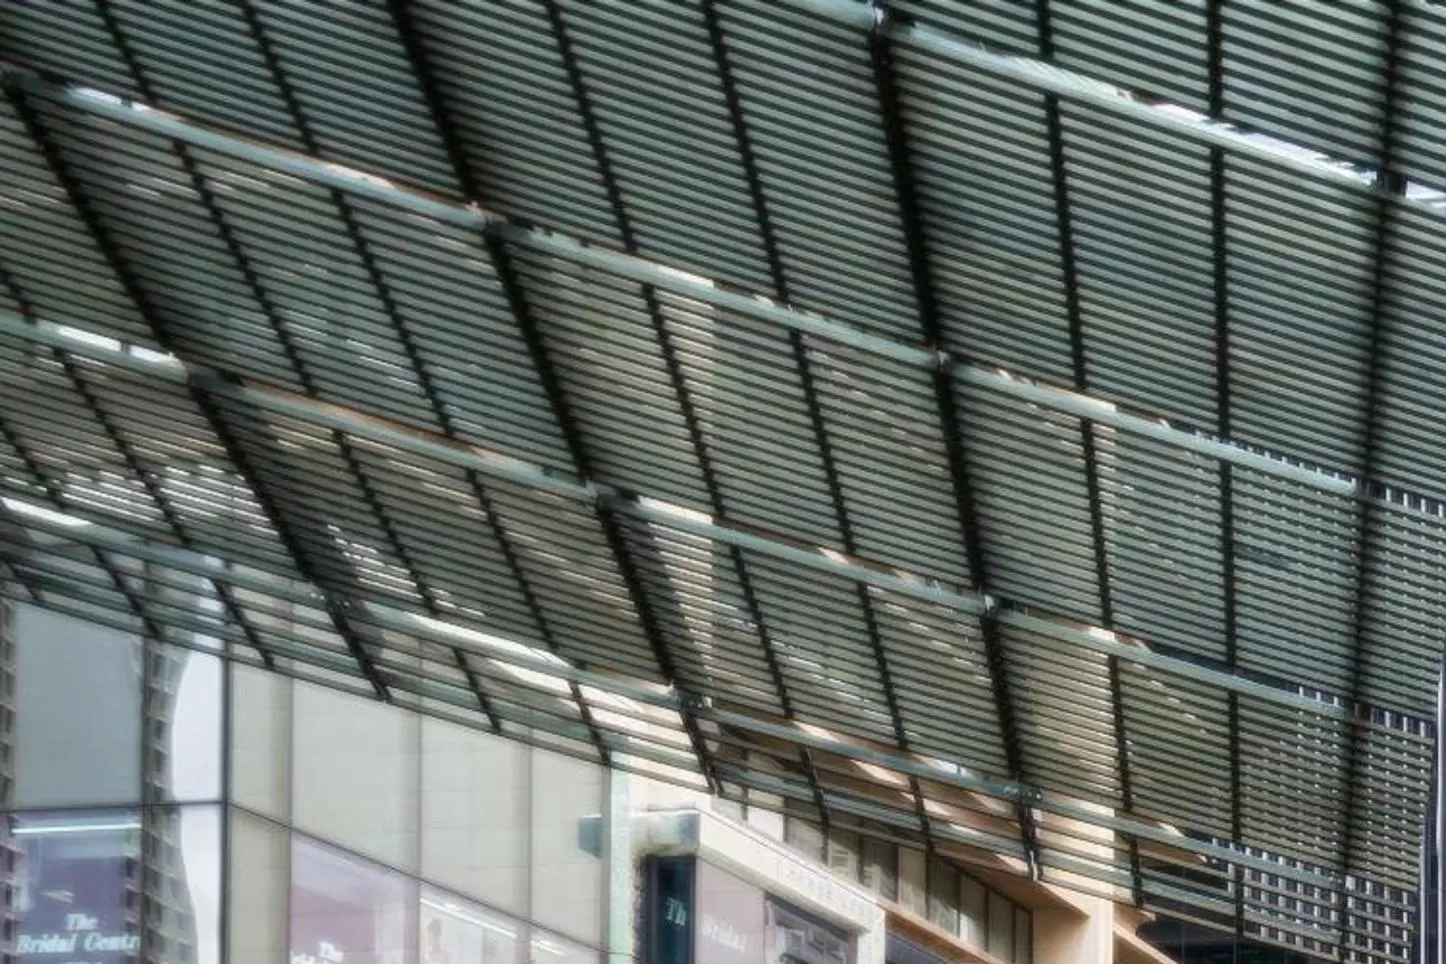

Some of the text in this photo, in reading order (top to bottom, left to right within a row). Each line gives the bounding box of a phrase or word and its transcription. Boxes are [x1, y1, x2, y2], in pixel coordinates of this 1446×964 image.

[66, 913, 97, 930] The
[16, 932, 140, 953] Bridal Centr
